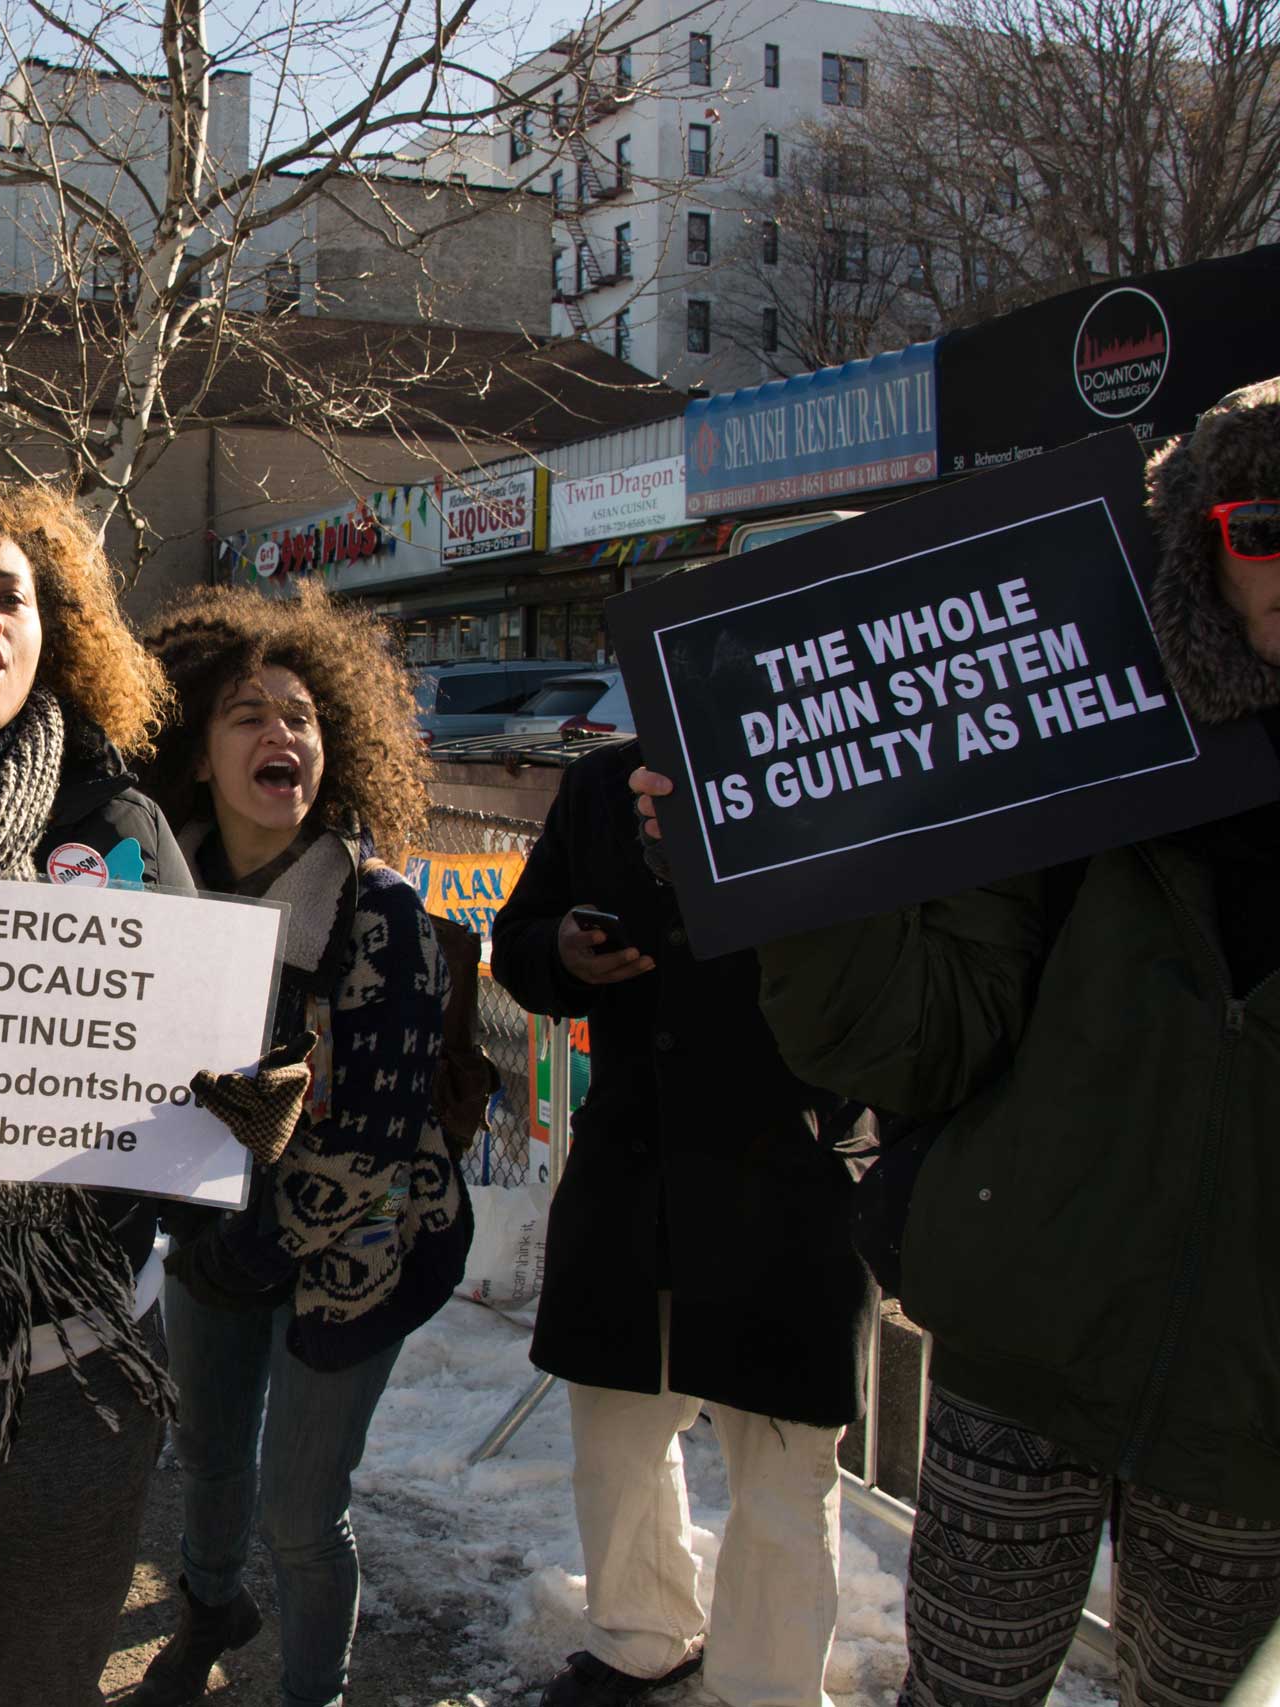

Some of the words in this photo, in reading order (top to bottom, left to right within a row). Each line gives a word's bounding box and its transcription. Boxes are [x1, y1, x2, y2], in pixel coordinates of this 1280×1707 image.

[1084, 359, 1160, 391] DOWNTOWN
[1093, 389, 1111, 403] PIZZA
[1118, 382, 1151, 400] BURGERS
[724, 406, 786, 470] SPANISH
[795, 378, 910, 457] RESTAURANT
[915, 371, 931, 433] II
[829, 474, 843, 490] EAT
[847, 472, 856, 487] IN
[866, 465, 888, 484] TAKE
[890, 461, 909, 480] OUT
[974, 447, 1012, 466] Richmond
[566, 479, 605, 505] Twin
[610, 459, 686, 498] Dragon's
[448, 496, 526, 541] LIQUORS
[591, 506, 620, 521] ASIAN
[620, 498, 657, 515] CUISINE
[322, 518, 378, 563] PLUS
[754, 629, 856, 693] THE
[858, 577, 1038, 664] WHOLE
[740, 680, 881, 758] DAMN
[888, 622, 1089, 716] SYSTEM
[704, 773, 754, 825] IS
[764, 722, 934, 808] GUILTY
[957, 703, 1020, 762] AS
[1027, 665, 1167, 739] HELL
[441, 867, 505, 900] PLAY
